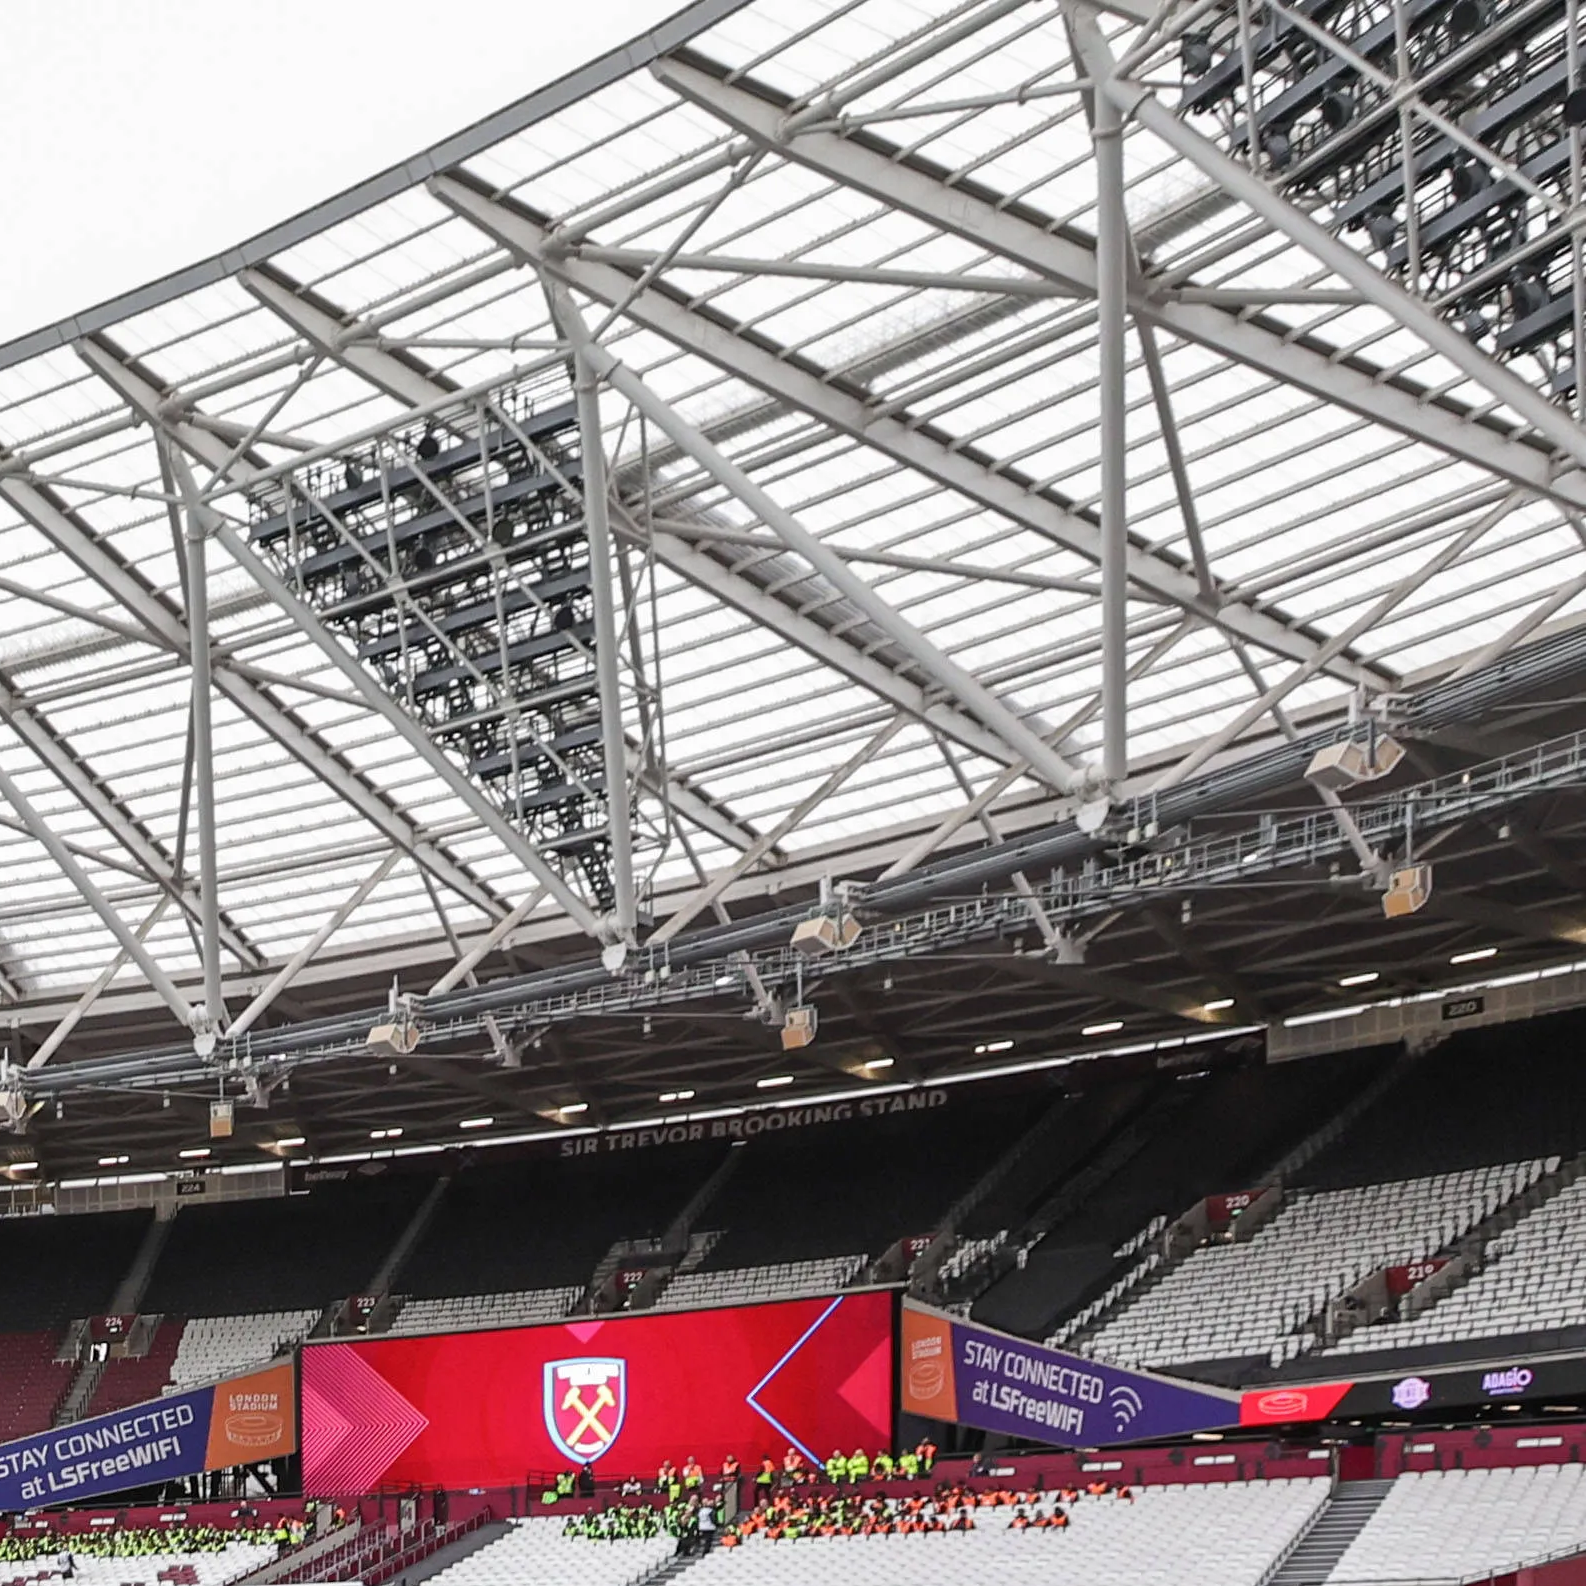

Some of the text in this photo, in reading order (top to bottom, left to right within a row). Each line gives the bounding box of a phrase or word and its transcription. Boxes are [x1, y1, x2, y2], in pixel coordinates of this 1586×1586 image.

[560, 1089, 948, 1157] SIR TREVOR BROOKING STAND
[105, 1317, 124, 1327] 224
[357, 1297, 376, 1308] 223
[229, 1393, 278, 1402] LONDON
[963, 1340, 1104, 1404] STAY CONNECTED
[54, 1404, 194, 1461] CONNECTED
[229, 1401, 278, 1411] STADIUM
[972, 1378, 1085, 1436] at LSFreeWIFI
[21, 1436, 182, 1500] at LSFreeWIFI
